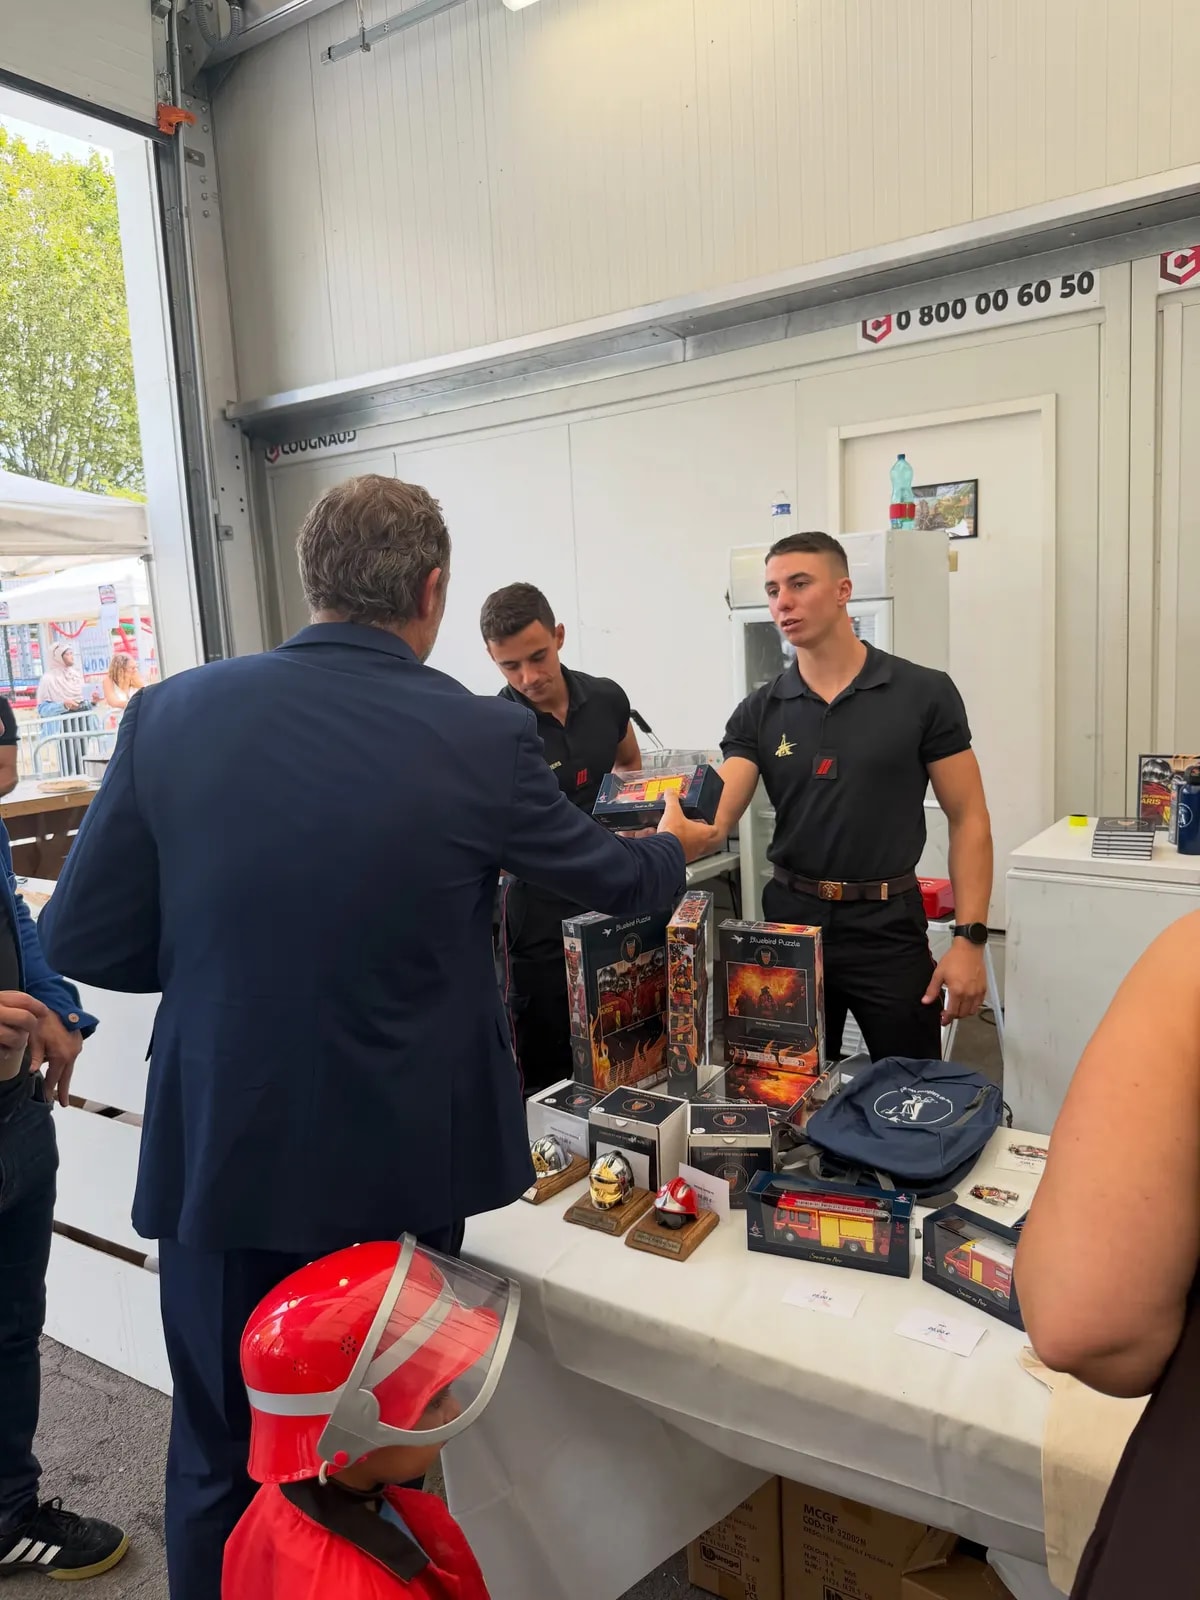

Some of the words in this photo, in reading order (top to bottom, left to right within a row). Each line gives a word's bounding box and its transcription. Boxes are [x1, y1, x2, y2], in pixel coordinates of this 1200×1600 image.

[896, 311, 911, 331] 0
[918, 297, 967, 326] 800
[975, 289, 1009, 315] 00
[1016, 280, 1051, 307] 60
[1060, 270, 1095, 299] 50
[1141, 798, 1161, 806] ARIS
[749, 935, 777, 945] Bluebird
[778, 938, 801, 947] Puzzle
[804, 1503, 838, 1524] MCGF
